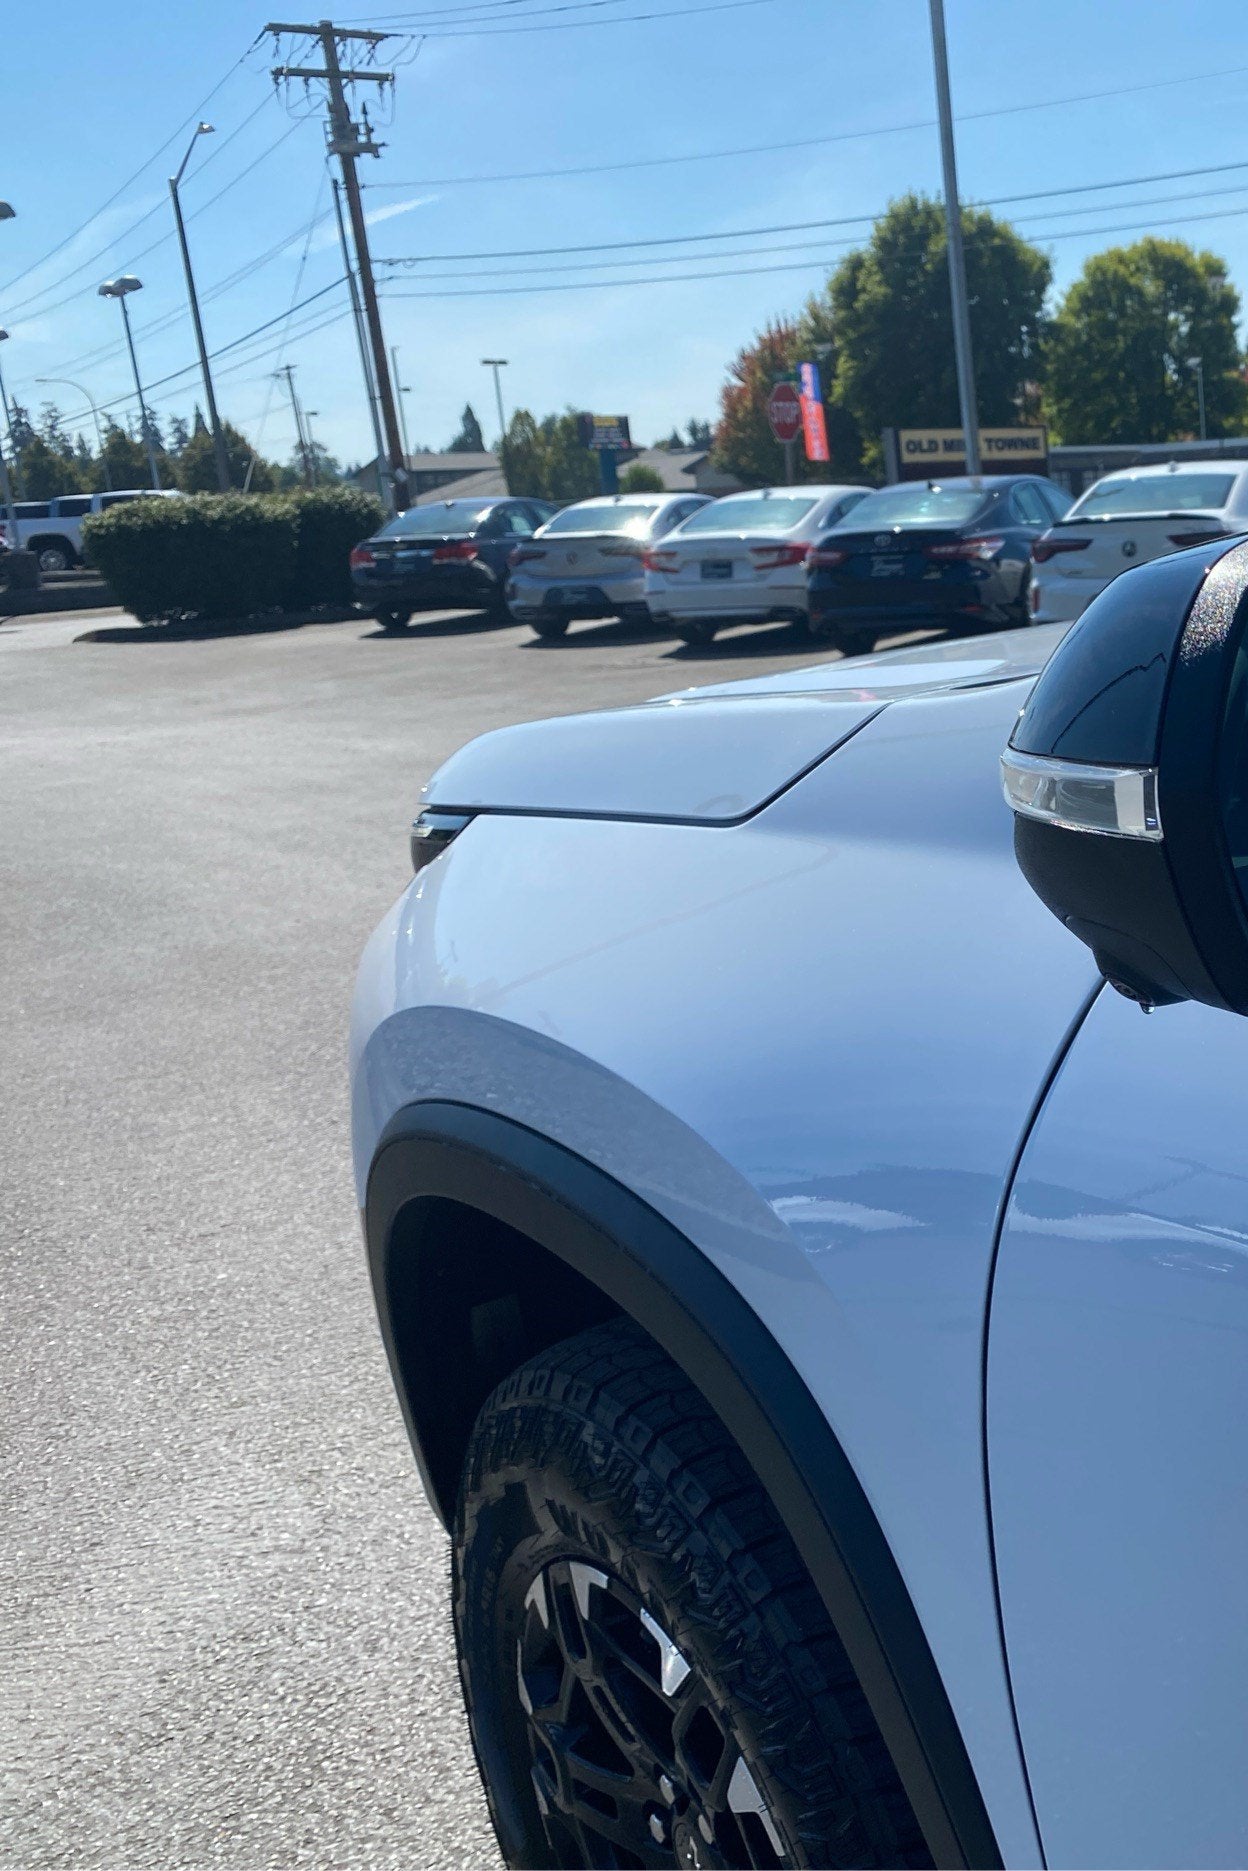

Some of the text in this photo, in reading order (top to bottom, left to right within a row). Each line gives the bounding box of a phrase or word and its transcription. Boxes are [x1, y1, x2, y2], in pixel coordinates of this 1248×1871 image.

[768, 401, 799, 424] STOP
[905, 439, 939, 453] OLD
[984, 436, 1040, 452] TOWNE
